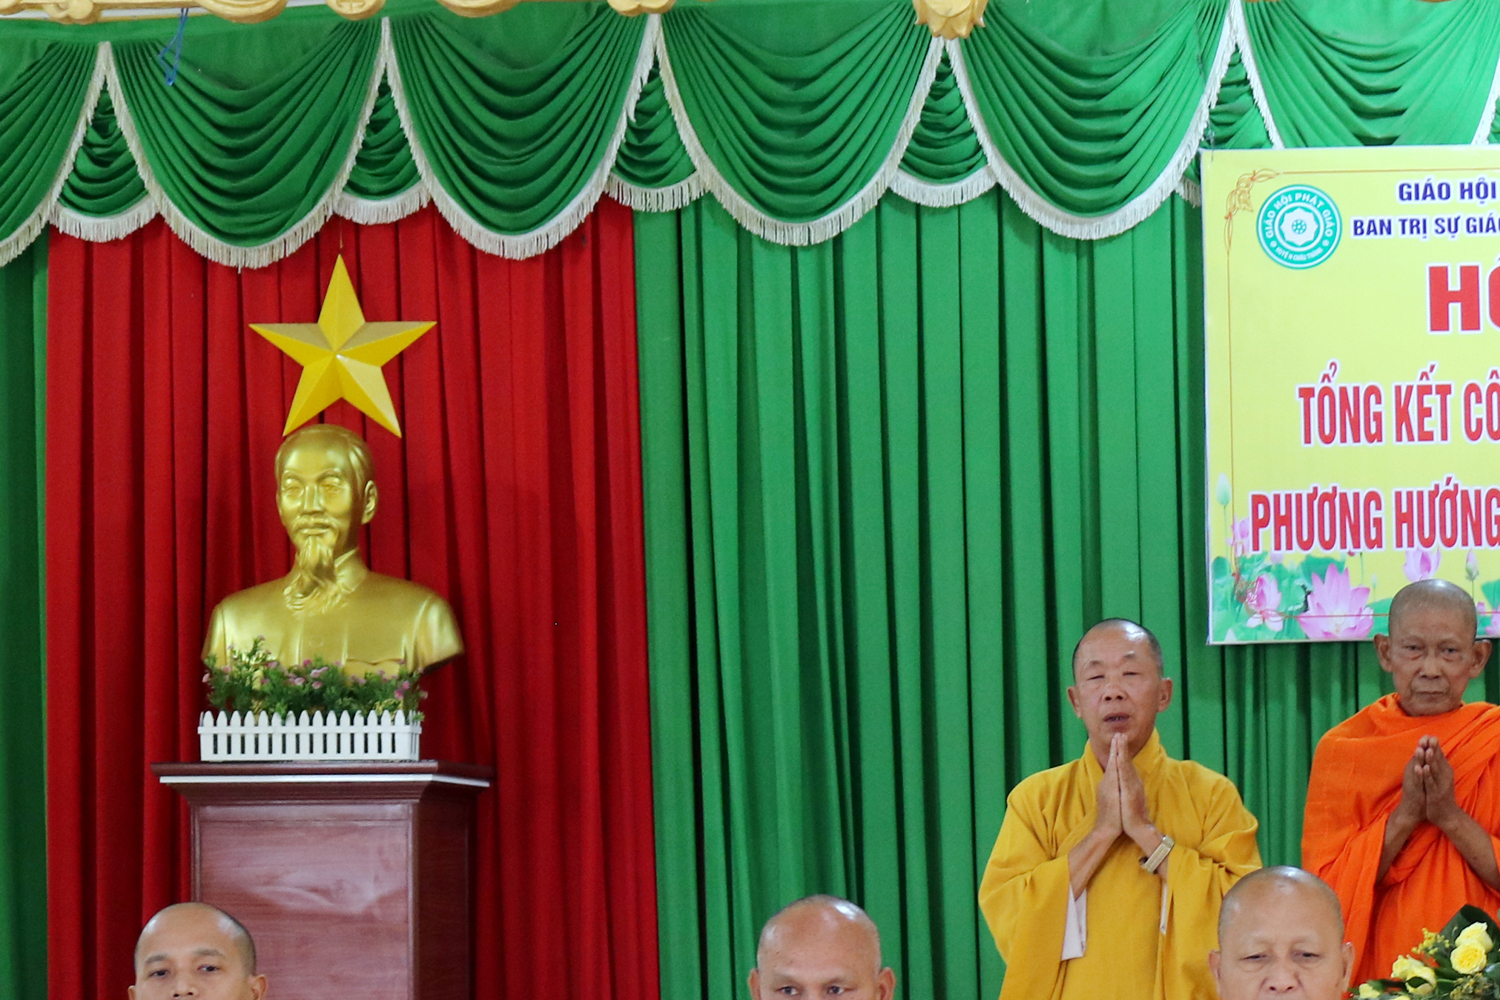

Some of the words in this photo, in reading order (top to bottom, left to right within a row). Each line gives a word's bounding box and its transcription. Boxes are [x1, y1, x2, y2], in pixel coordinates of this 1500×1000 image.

[1398, 178, 1451, 201] GIÁO
[1459, 177, 1497, 204] HỘI
[1353, 218, 1392, 236] BAN
[1398, 218, 1428, 239] TRỊ
[1434, 215, 1461, 239] SỰ
[1298, 362, 1383, 445] TỔNG
[1394, 364, 1452, 442] KẾT
[1251, 486, 1383, 551] PHƯƠNG
